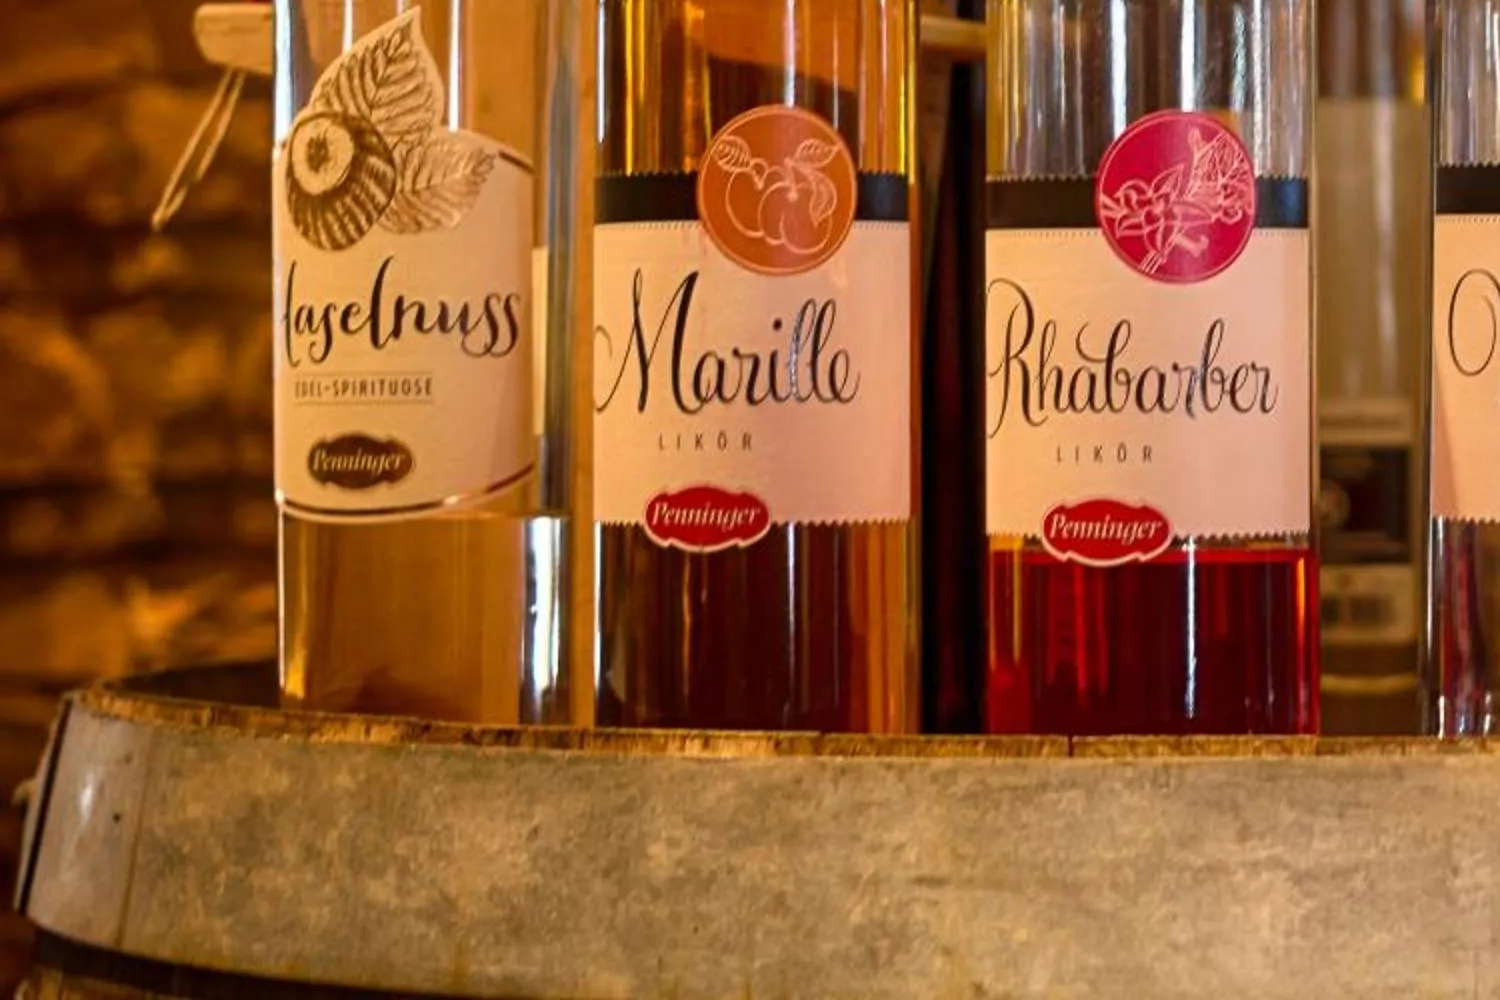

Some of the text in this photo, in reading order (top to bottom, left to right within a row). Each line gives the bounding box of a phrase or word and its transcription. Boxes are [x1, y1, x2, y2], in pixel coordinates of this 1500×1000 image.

[594, 267, 861, 415] Marille
[987, 277, 1279, 439] Rhabarber
[658, 430, 753, 451] LIKÖR
[1056, 443, 1153, 464] LIKÖR
[312, 447, 405, 474] Penninger
[652, 500, 761, 532] Penninger
[1049, 512, 1162, 545] Penninger
